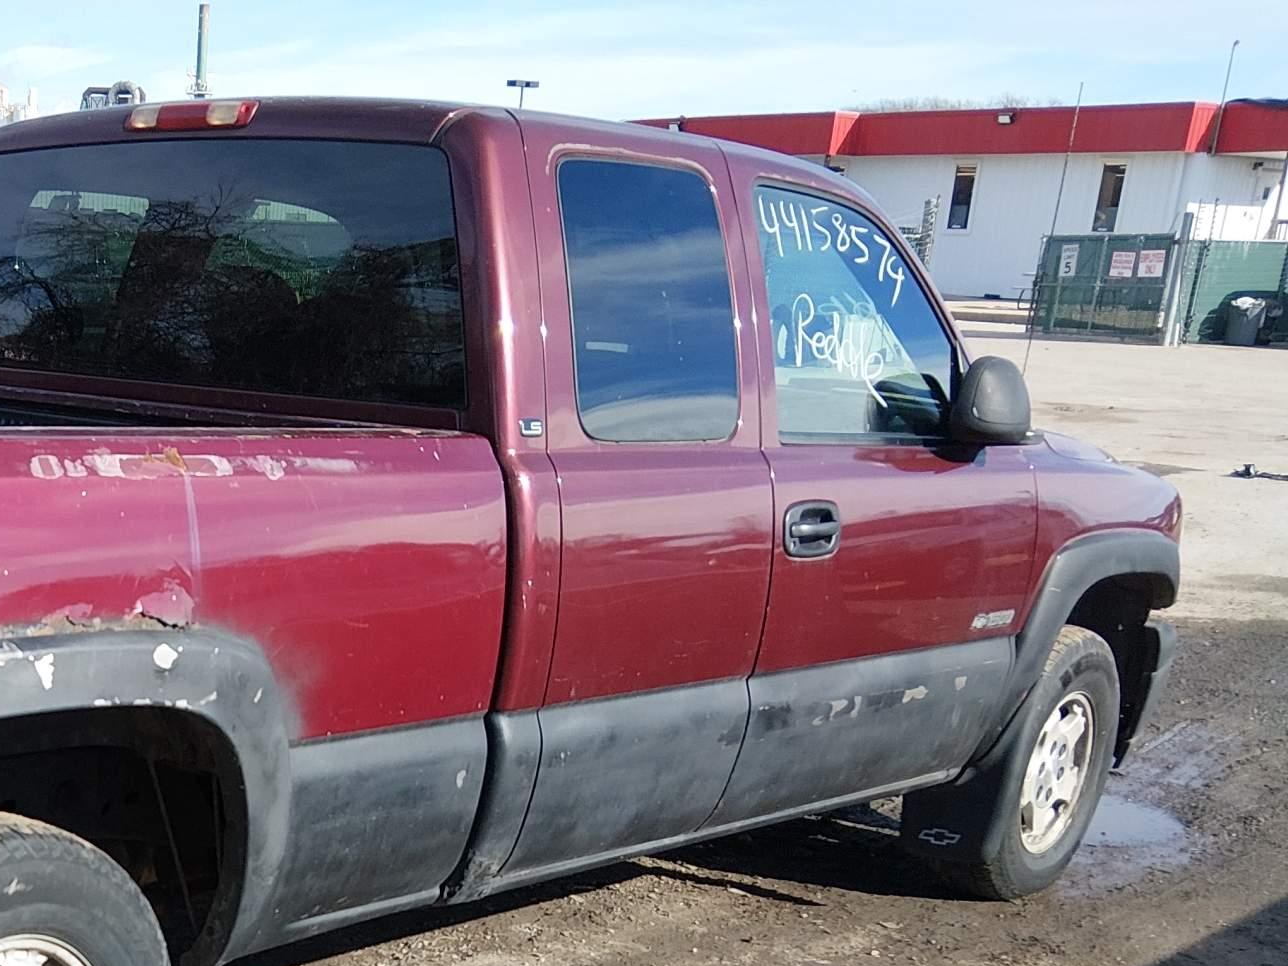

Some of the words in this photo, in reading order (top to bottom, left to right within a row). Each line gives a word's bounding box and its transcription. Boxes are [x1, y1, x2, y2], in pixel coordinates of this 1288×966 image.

[758, 195, 905, 307] 44158574
[1063, 262, 1073, 274] 5
[518, 420, 543, 435] LS
